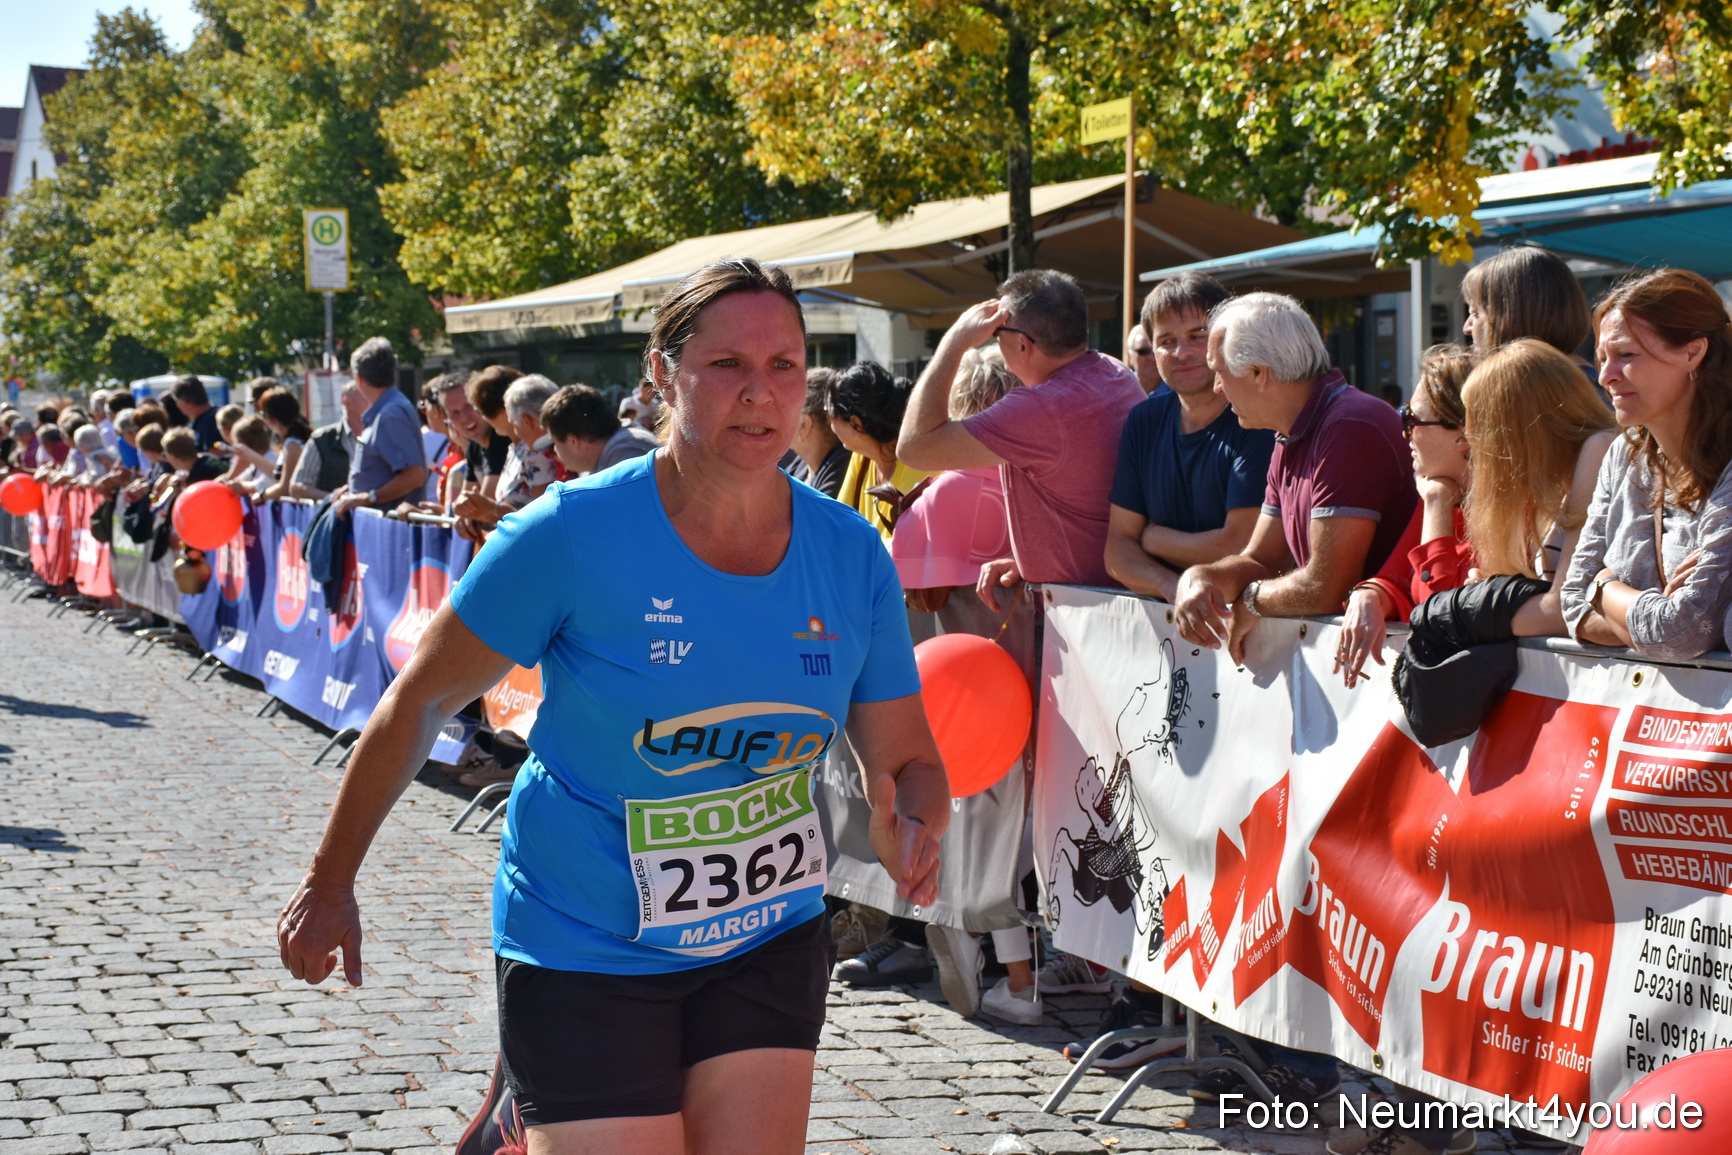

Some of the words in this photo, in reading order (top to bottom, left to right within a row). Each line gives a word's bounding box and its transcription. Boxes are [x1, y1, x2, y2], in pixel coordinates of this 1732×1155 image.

[1091, 113, 1128, 131] Toiletten
[1558, 132, 1662, 166] vodafo
[320, 222, 334, 239] H
[644, 612, 683, 624] erima
[649, 639, 694, 665] BLV
[800, 653, 831, 676] TUM
[1565, 786, 1585, 820] Seit
[1579, 736, 1600, 779] 1929
[1624, 760, 1732, 793] VERZURRSY
[648, 776, 799, 842] BOCK
[1619, 808, 1732, 838] RUNDSCHL
[808, 829, 815, 839] D
[1431, 813, 1448, 844] 1929
[659, 832, 806, 914] 2362
[1427, 846, 1437, 870] Seit
[678, 901, 787, 946] MARGIT
[1294, 847, 1386, 994] Braun
[1645, 906, 1686, 939] Braun
[1247, 948, 1263, 969] Sicher
[1420, 899, 1595, 1032] Braun
[1639, 939, 1661, 966] Am
[1328, 949, 1347, 985] Sicher
[1346, 978, 1358, 996] ist
[1357, 993, 1382, 1024] sicher
[1634, 969, 1693, 1007] D-92318
[1700, 984, 1732, 1017] Neu
[1482, 1020, 1530, 1055] Sicher
[1534, 1035, 1555, 1062] ist
[1556, 1043, 1592, 1074] sicher
[1628, 1013, 1655, 1043] Tel.
[1661, 1022, 1706, 1054] 09181
[1626, 1045, 1656, 1073] Fax
